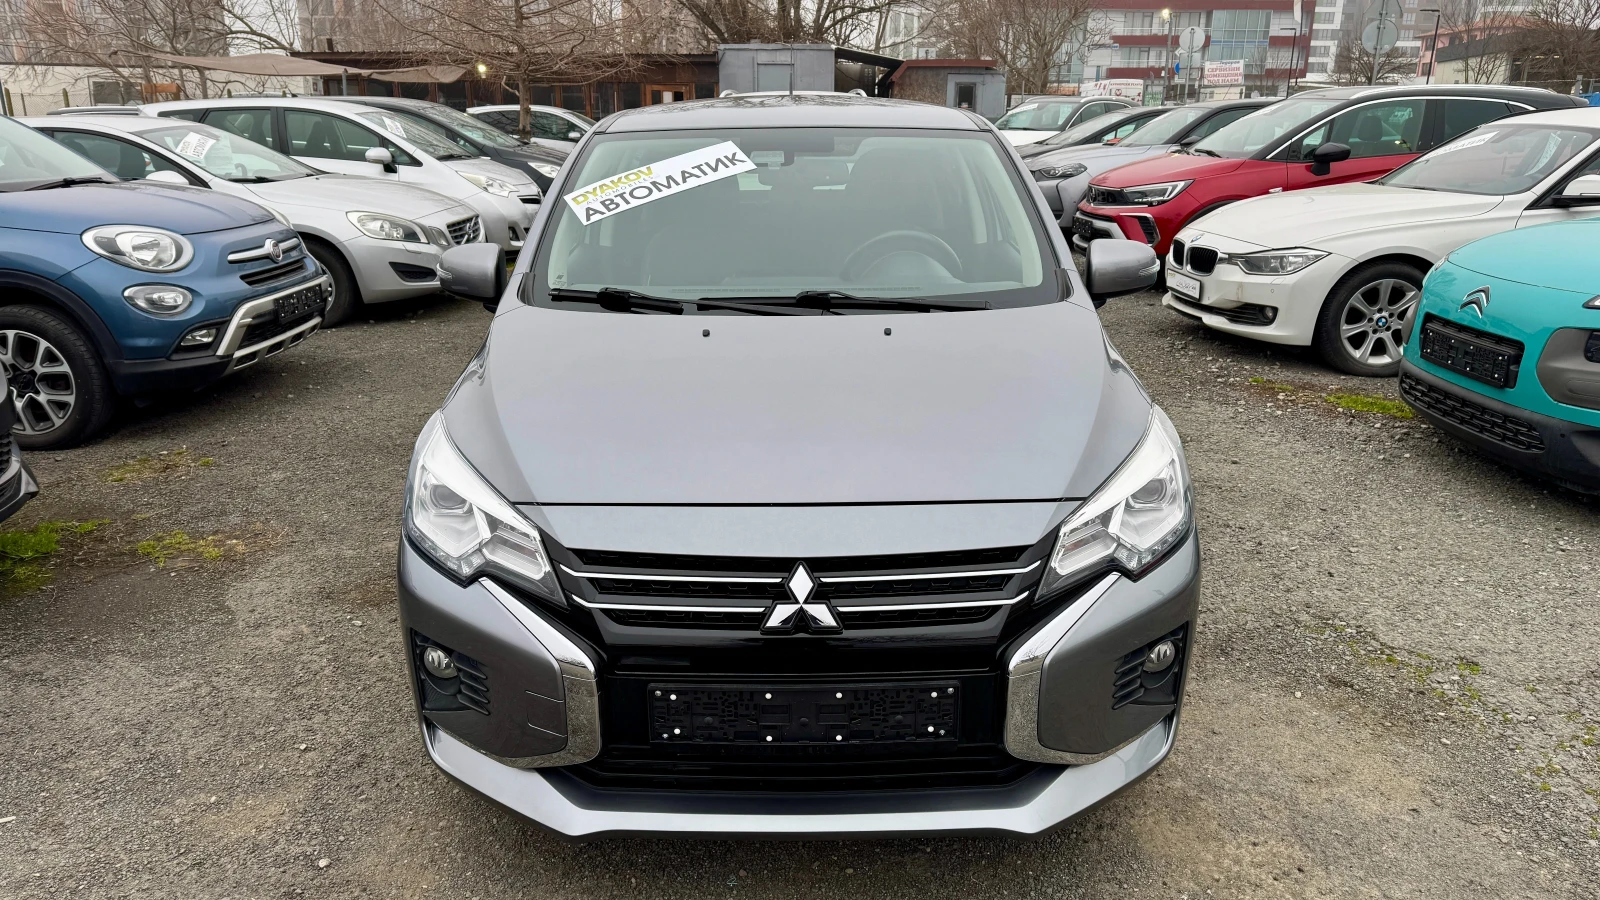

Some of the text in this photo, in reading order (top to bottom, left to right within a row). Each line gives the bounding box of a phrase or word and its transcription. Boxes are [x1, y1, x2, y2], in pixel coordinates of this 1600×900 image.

[571, 166, 653, 206] DYAKOV
[585, 152, 747, 222] АВТОМАТИК
[586, 175, 654, 205] AUTOMOBILES
